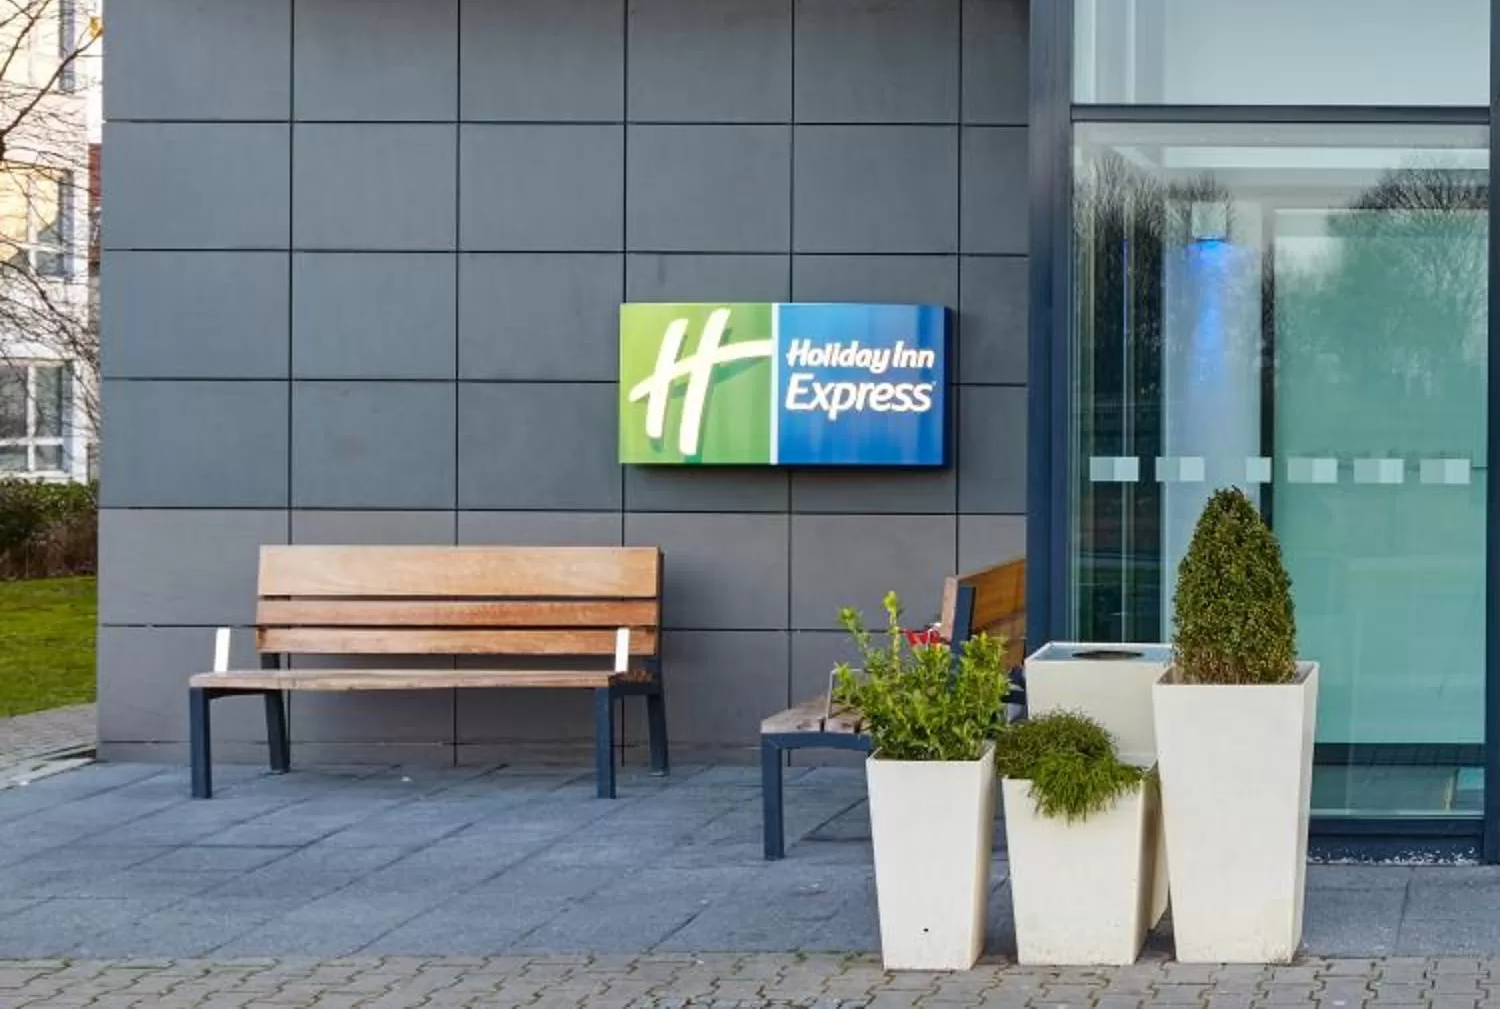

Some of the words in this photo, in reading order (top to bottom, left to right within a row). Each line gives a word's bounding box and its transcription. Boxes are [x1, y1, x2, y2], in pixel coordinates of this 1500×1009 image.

[786, 338, 890, 374] Holiday
[892, 341, 936, 368] Inn
[785, 373, 933, 421] Express
